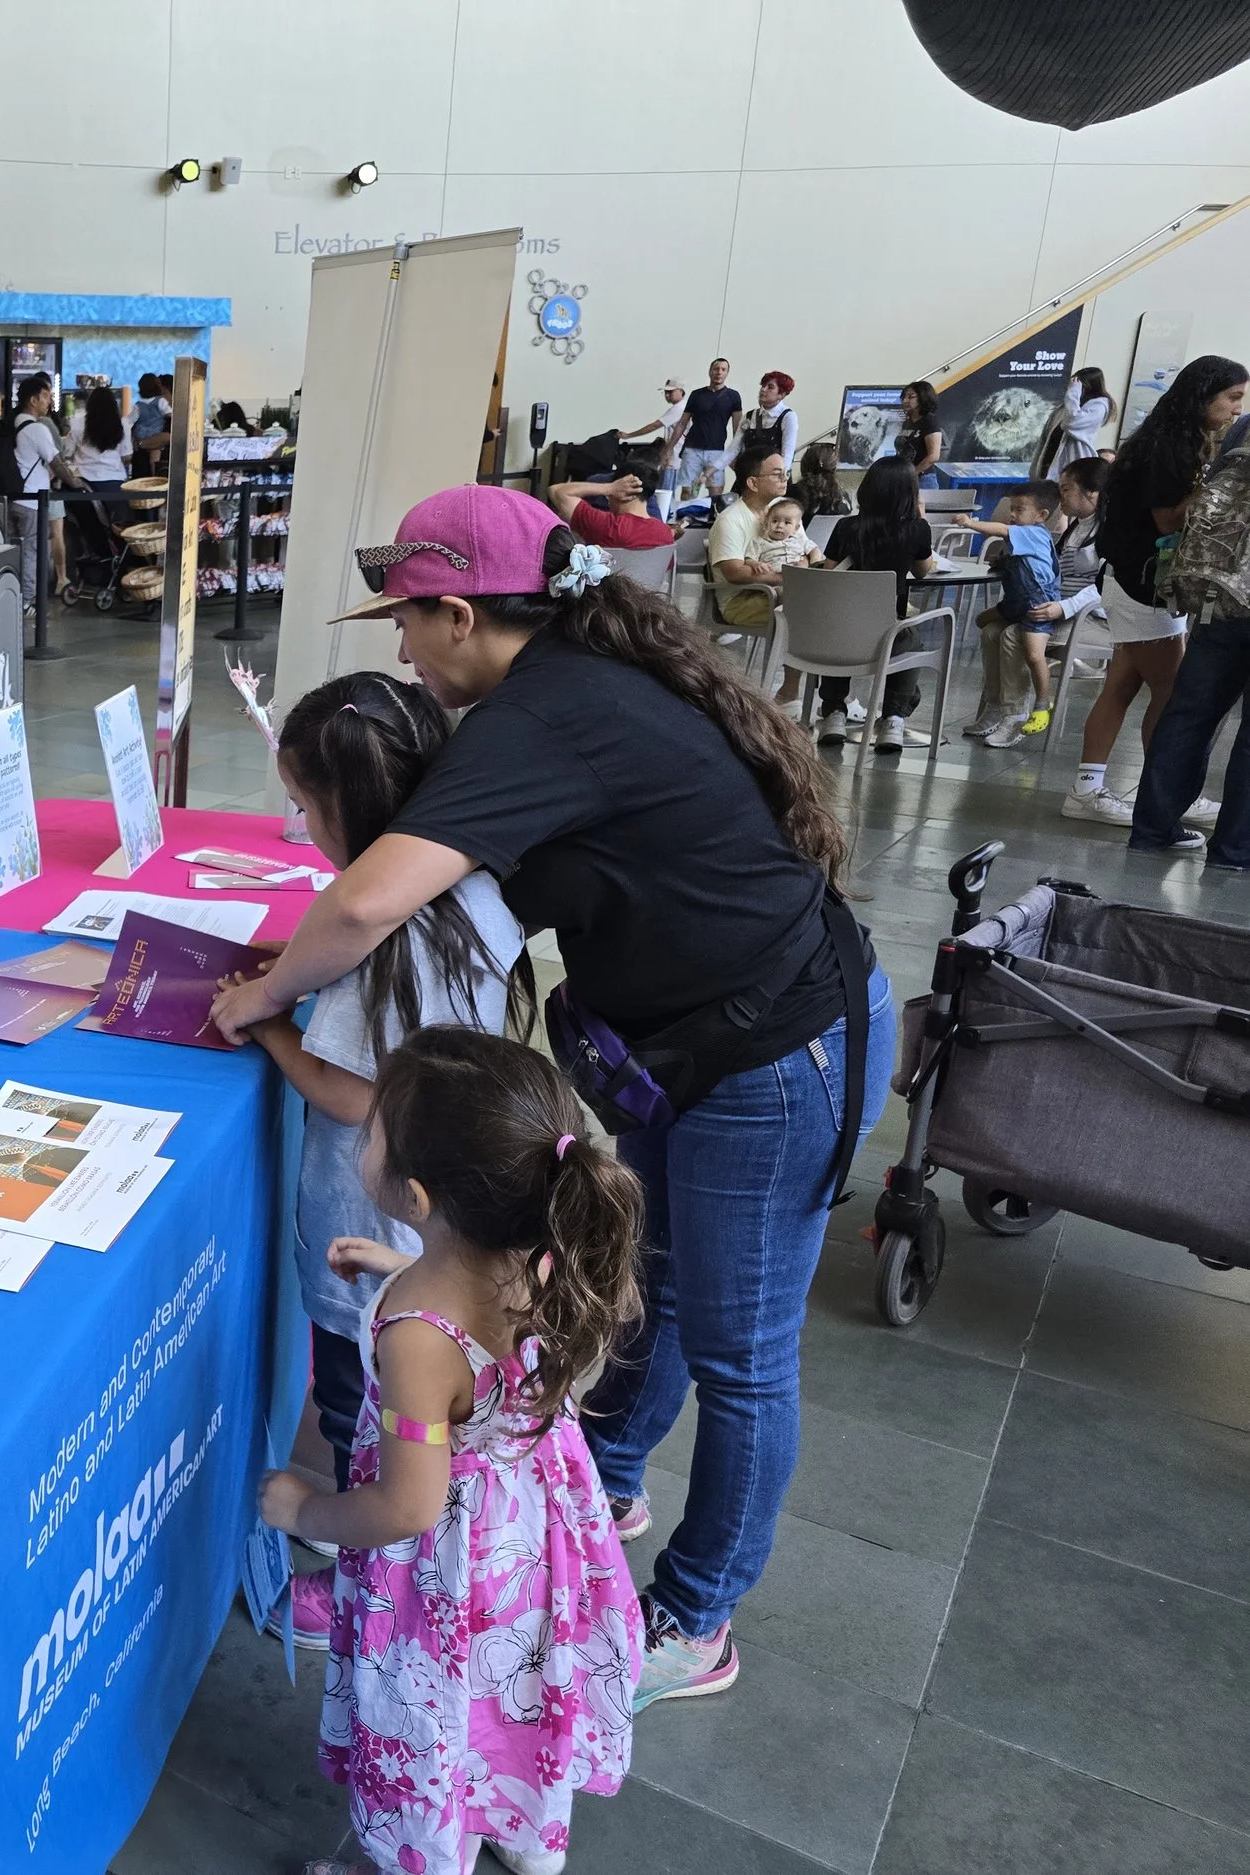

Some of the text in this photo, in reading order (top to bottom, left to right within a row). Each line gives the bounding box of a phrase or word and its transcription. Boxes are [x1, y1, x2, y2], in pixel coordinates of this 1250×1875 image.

[274, 224, 383, 255] Elevator
[1010, 361, 1064, 371] Your Love
[1035, 351, 1066, 361] Show
[26, 1249, 227, 1570] Latino and Latin American Art
[29, 1234, 216, 1524] Modern and Contemporary
[15, 1403, 223, 1762] MUSEUM OF LATIN AMERICAN ART
[18, 1466, 152, 1724] molaa
[26, 1583, 164, 1854] Long Beach, California
